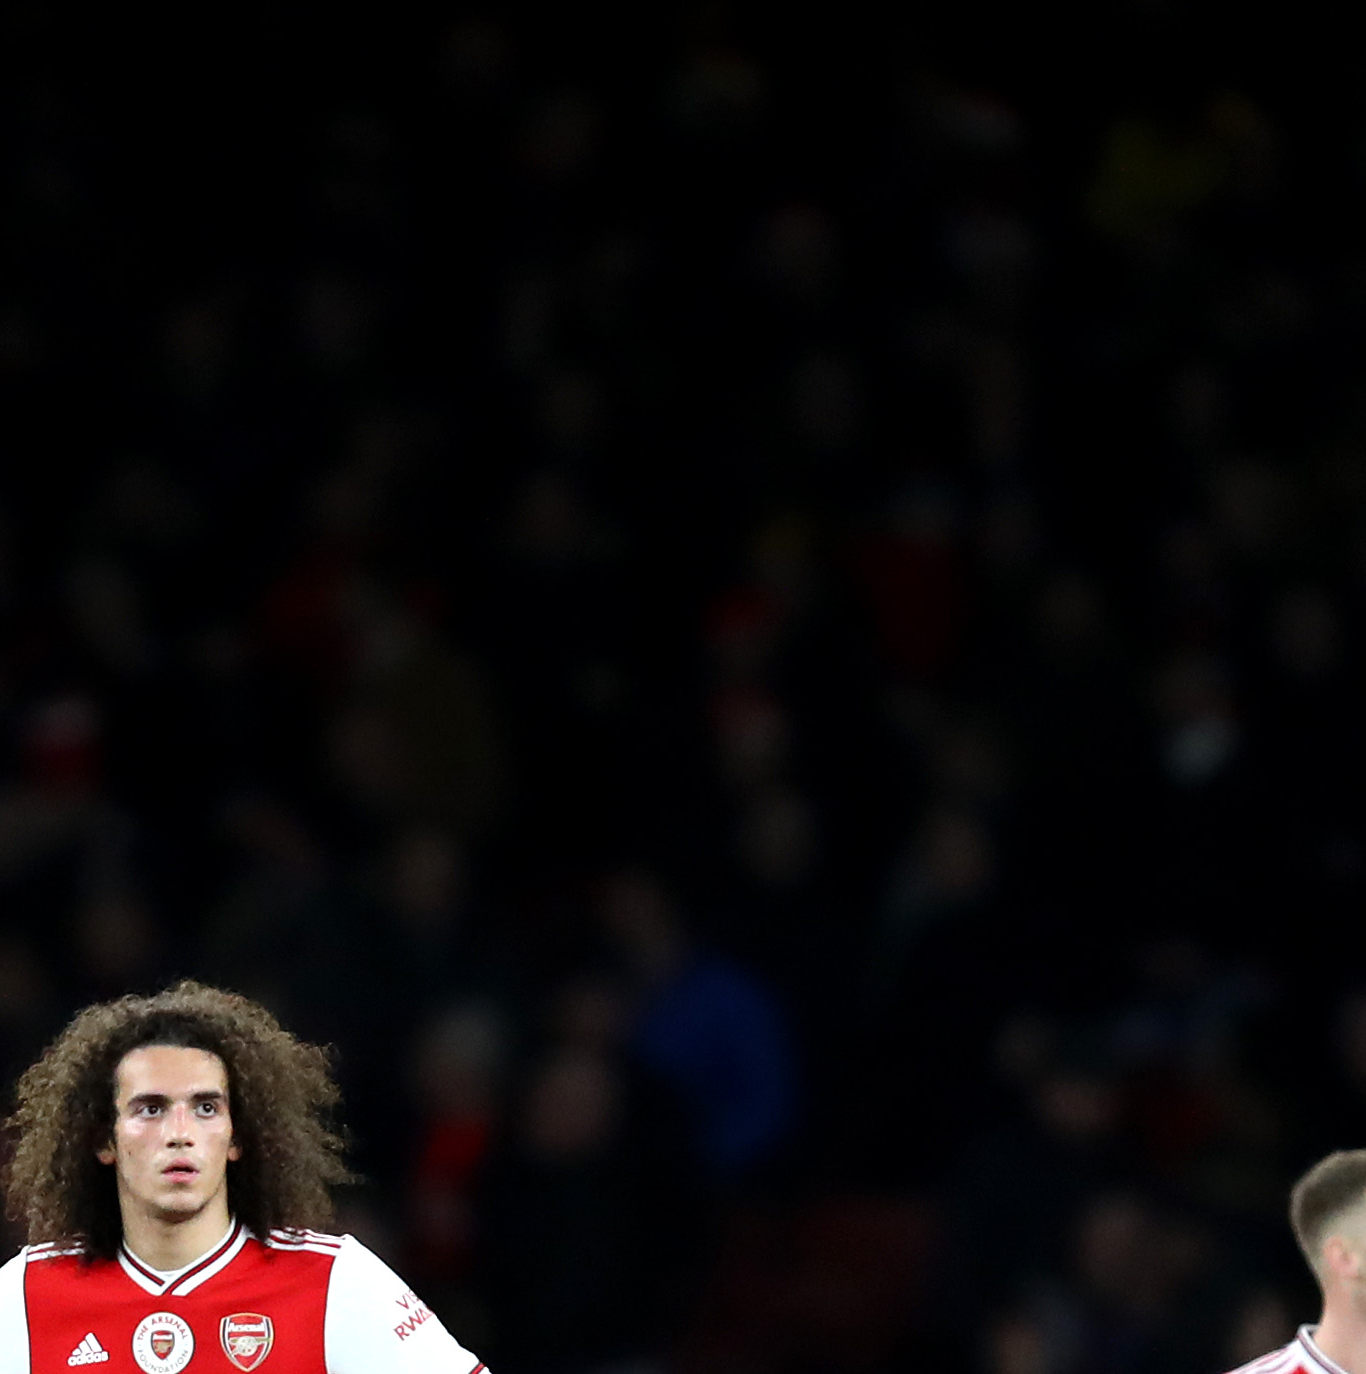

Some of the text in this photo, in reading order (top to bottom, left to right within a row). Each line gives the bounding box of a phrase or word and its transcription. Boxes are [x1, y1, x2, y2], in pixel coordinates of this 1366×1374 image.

[137, 1316, 188, 1341] THE ARSENAL
[67, 1351, 110, 1367] adidas
[137, 1349, 189, 1374] FOUNDATION
